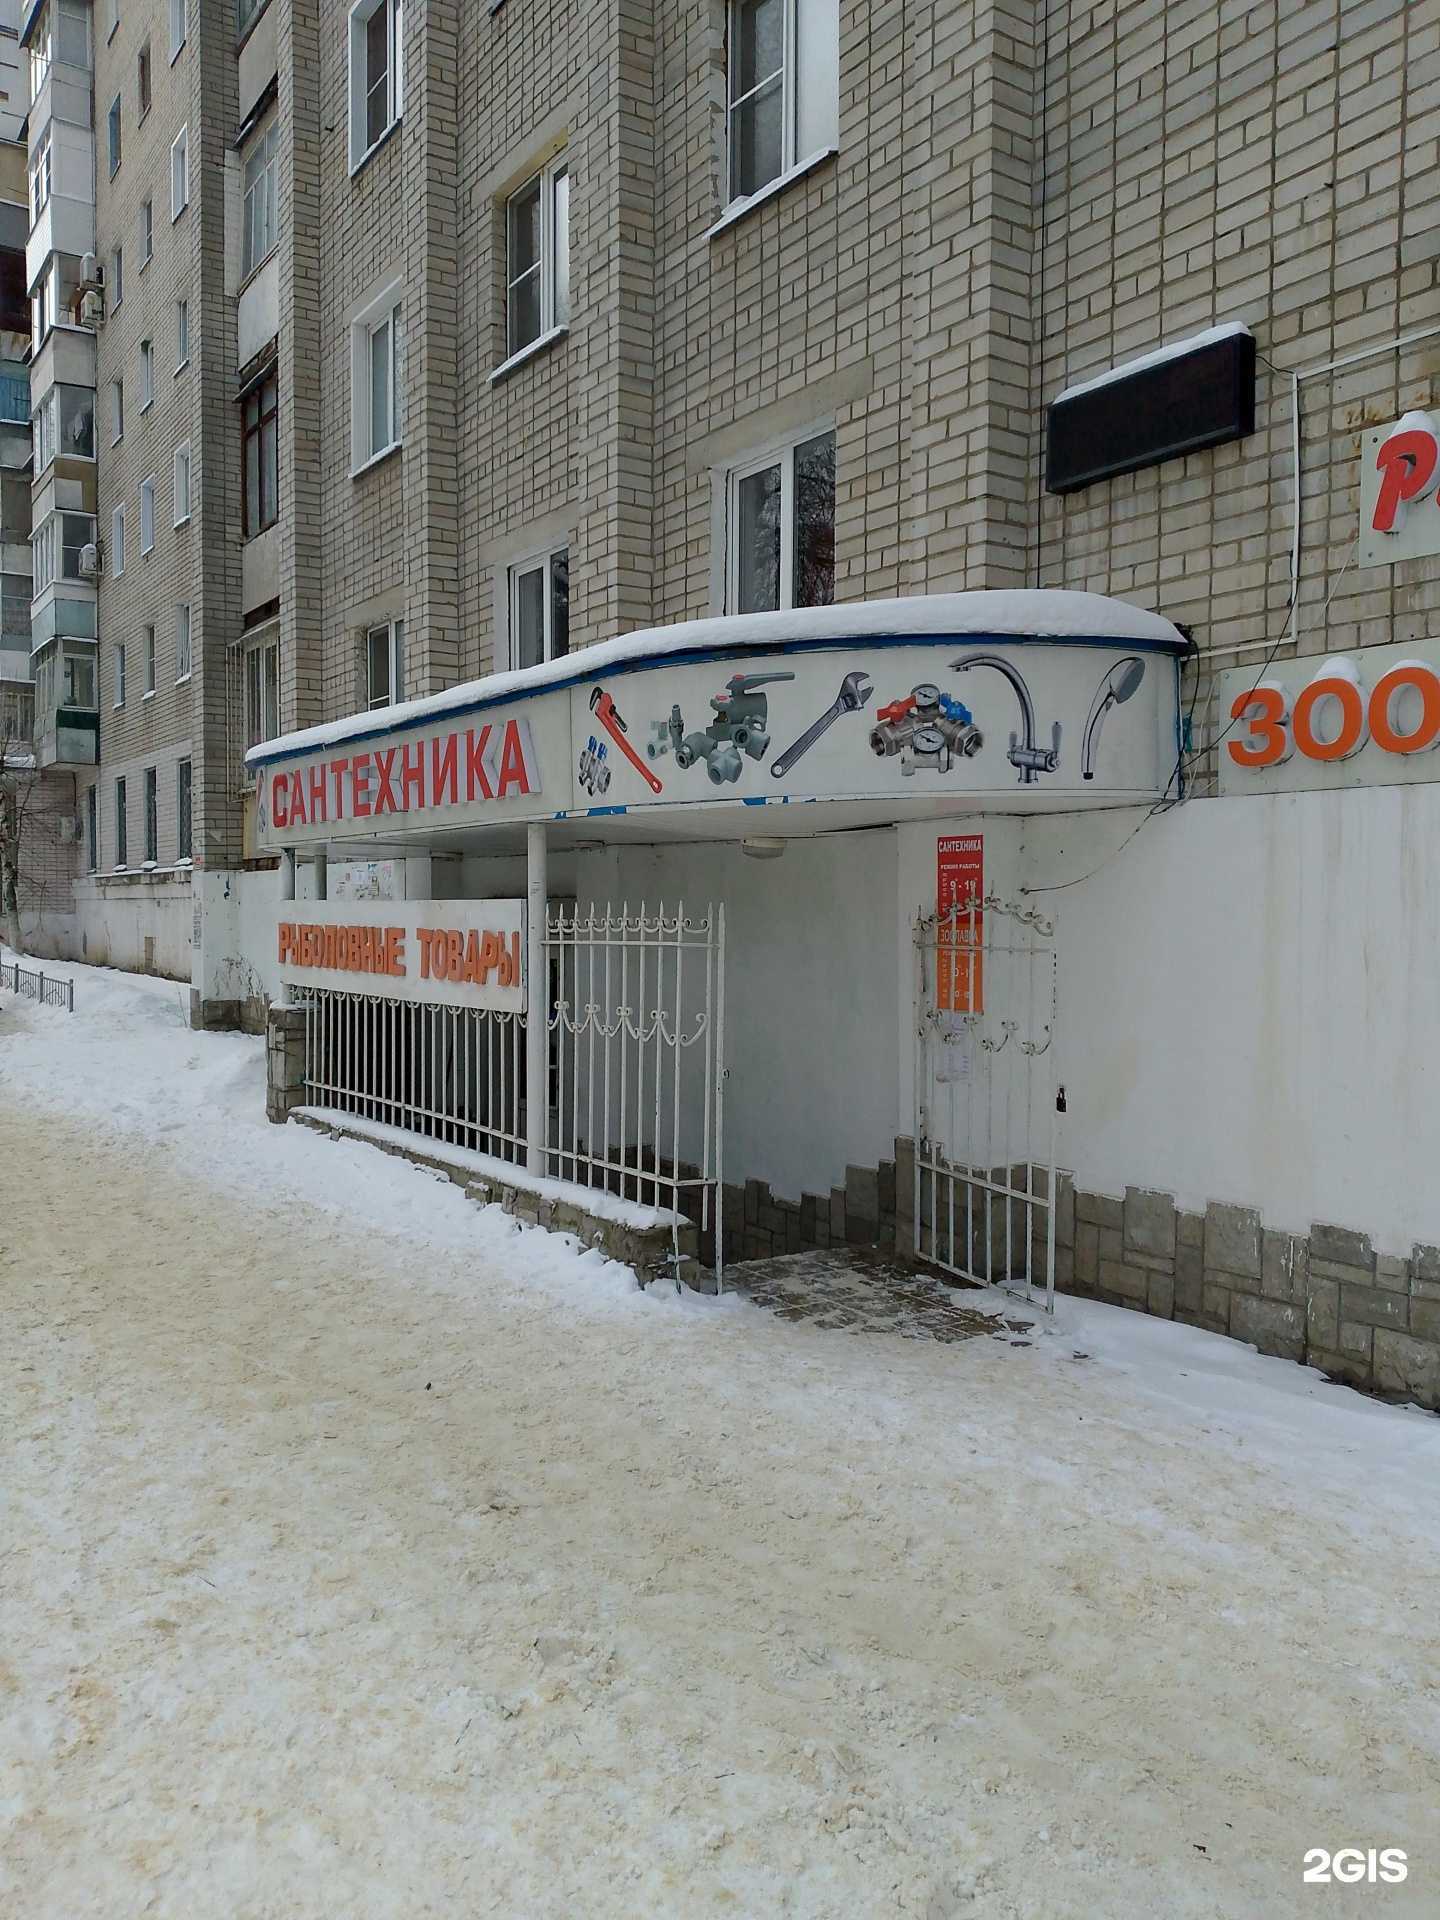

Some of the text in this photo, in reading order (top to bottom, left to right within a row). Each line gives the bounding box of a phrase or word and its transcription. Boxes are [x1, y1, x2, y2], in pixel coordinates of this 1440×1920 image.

[1372, 429, 1440, 531] Р
[272, 719, 532, 828] САНТЕХНИКА
[938, 839, 982, 853] САНТЕХНИКА
[278, 922, 520, 987] РЫБОЛОВНЫЕ ТОВАРЫ
